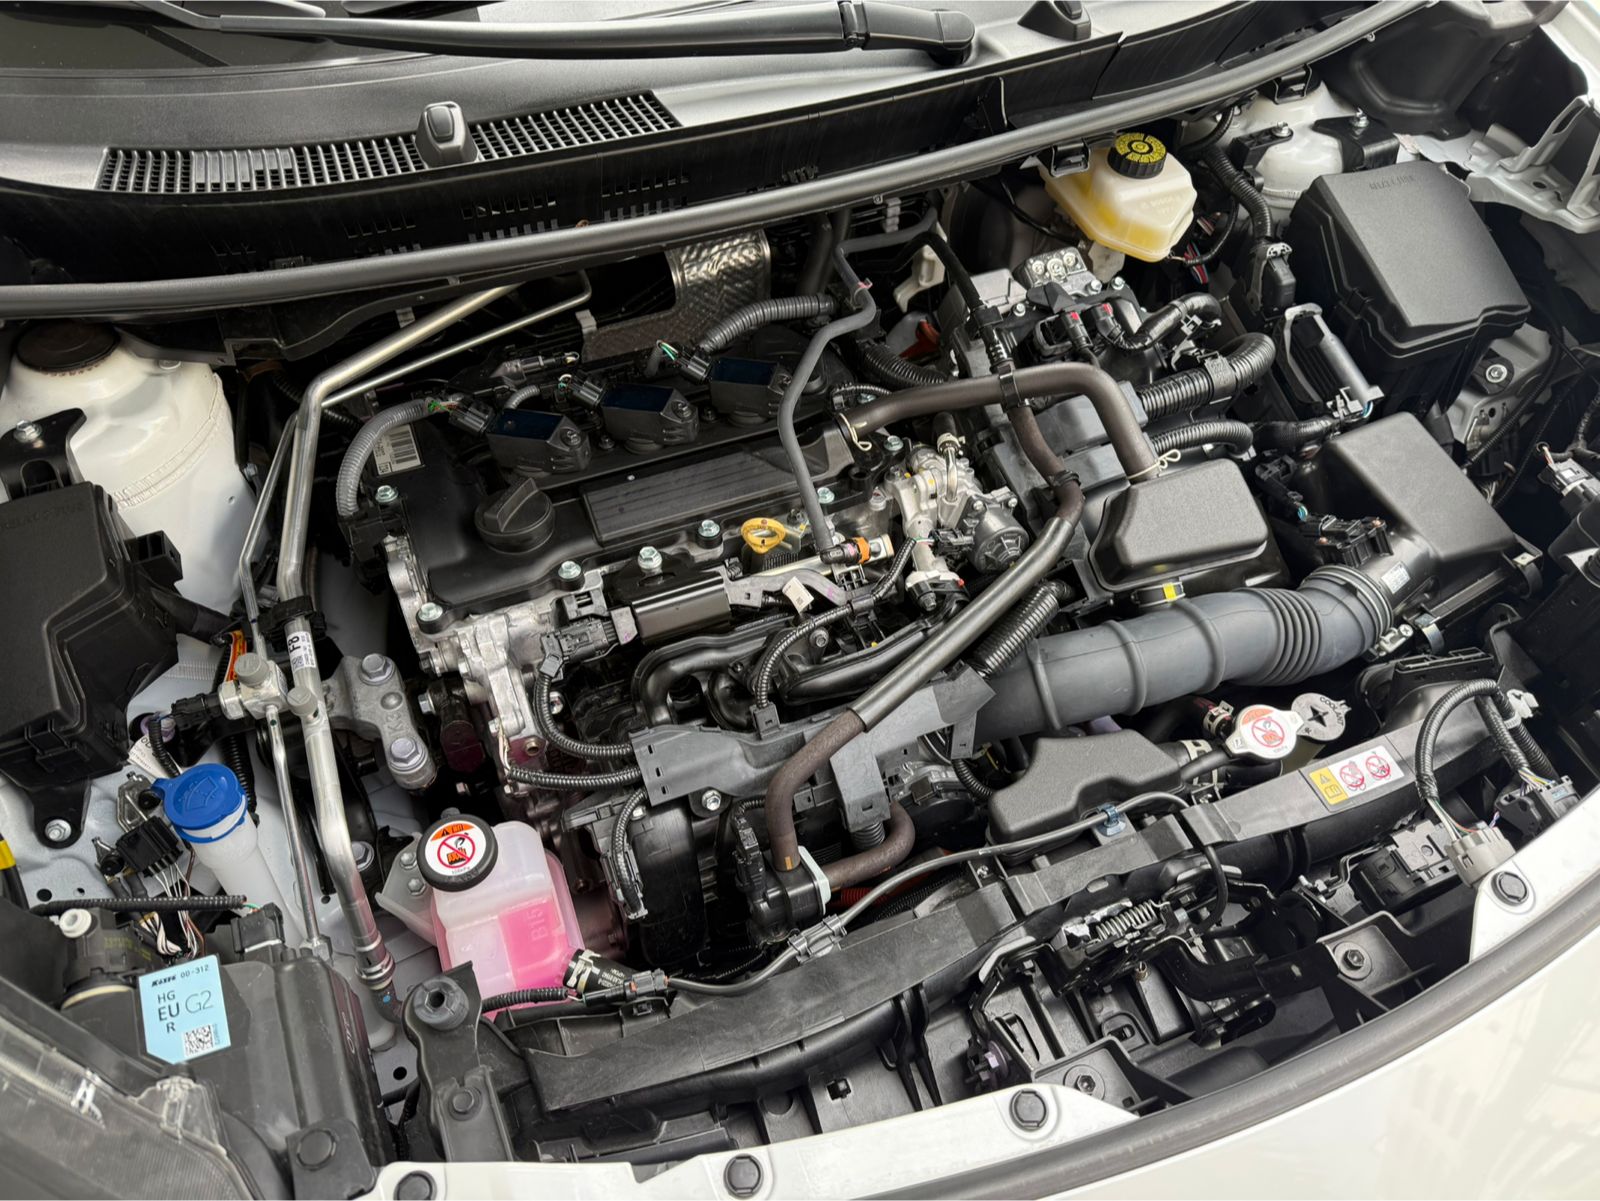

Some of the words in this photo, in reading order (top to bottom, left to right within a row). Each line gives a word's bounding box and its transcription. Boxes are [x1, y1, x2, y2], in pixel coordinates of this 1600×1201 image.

[288, 636, 301, 653] F8
[1319, 696, 1345, 726] COOLANT
[157, 990, 176, 1004] HG
[185, 989, 214, 1014] G2
[158, 1002, 180, 1021] EU
[166, 1021, 176, 1034] R
